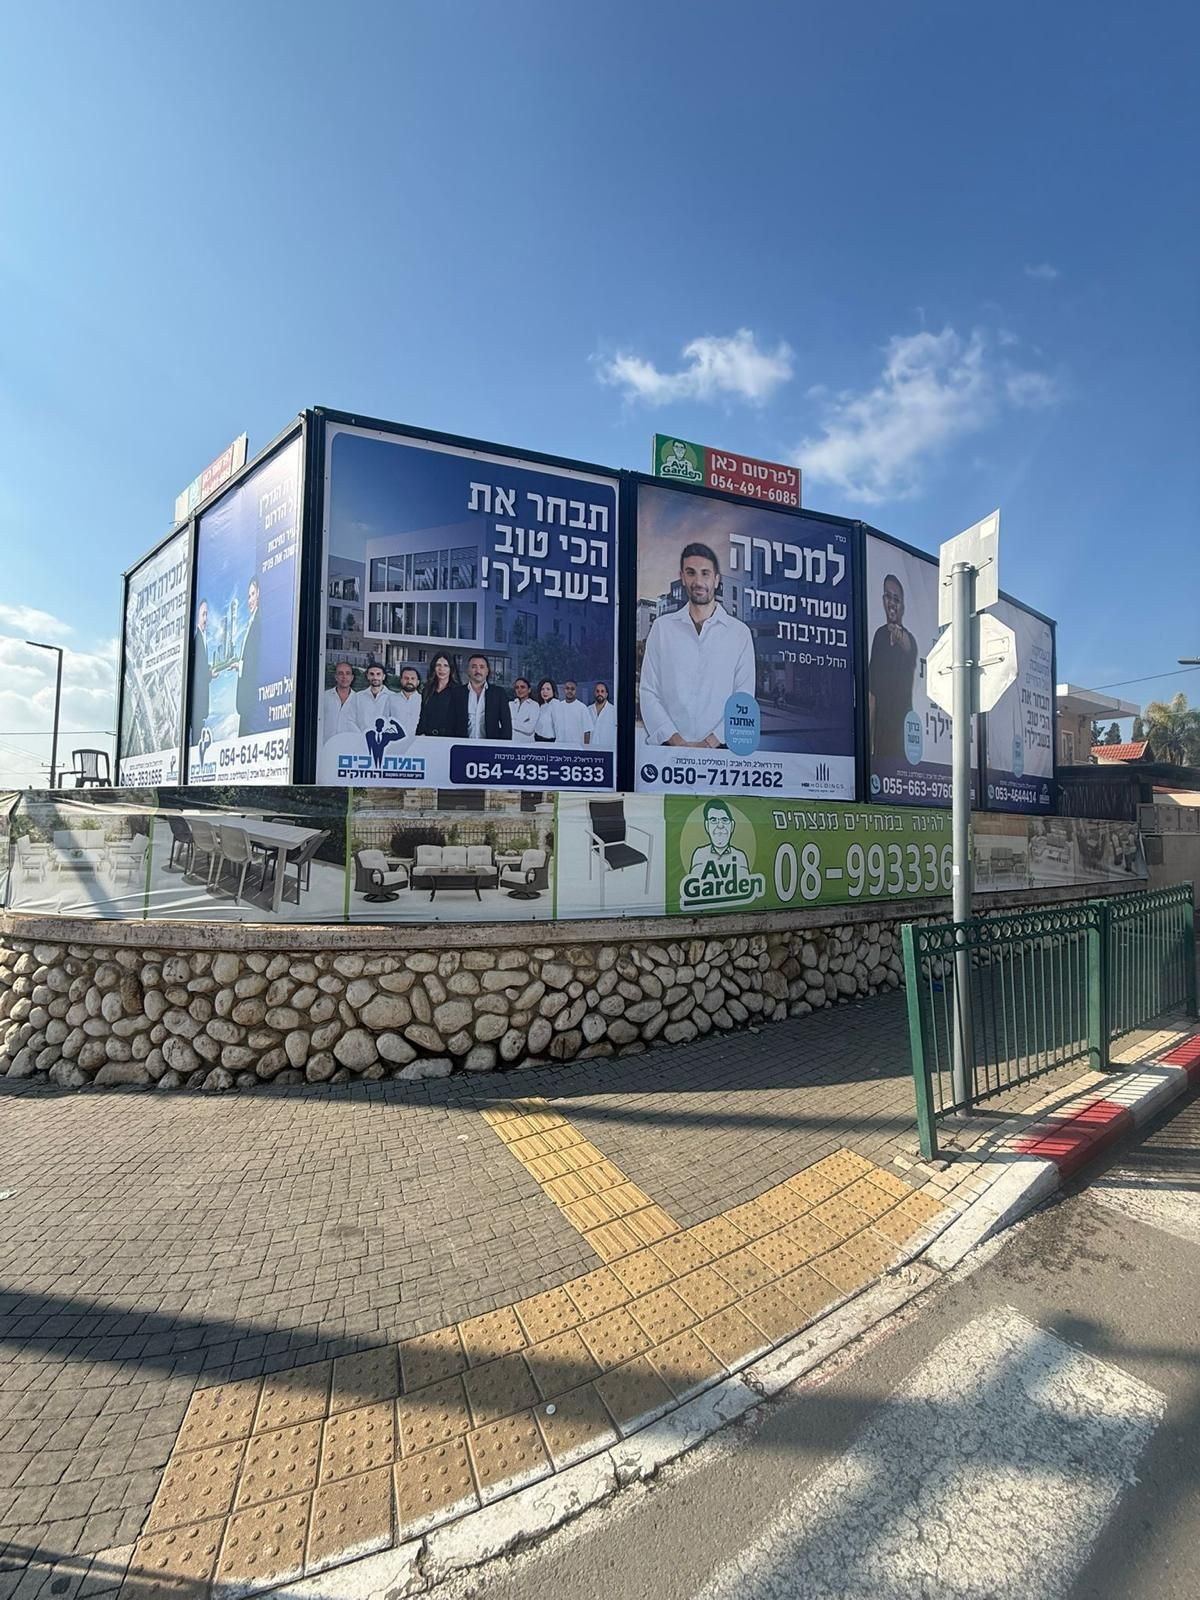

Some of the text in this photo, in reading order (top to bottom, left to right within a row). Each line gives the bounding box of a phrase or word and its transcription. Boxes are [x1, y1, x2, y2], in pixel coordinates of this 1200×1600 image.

[662, 464, 701, 481] Garden
[671, 460, 688, 469] Avi
[711, 454, 796, 486] לפרסום כאן
[711, 473, 797, 505] 054-491-6085
[468, 481, 609, 533] תבחר את
[495, 524, 608, 568] הכי טוב
[729, 533, 845, 586] למכירה
[481, 556, 609, 604] בשבילך!
[744, 587, 847, 621] שטחי מסחר
[777, 621, 848, 647] בנתיבות
[826, 654, 847, 669] החל
[1022, 688, 1032, 704] את
[736, 703, 748, 714] טל
[729, 717, 755, 727] אוחנה
[1027, 710, 1050, 730] הכי טוב
[338, 769, 382, 779] החזקים
[465, 761, 605, 783] 054-435-3633
[662, 766, 783, 788] 050-7171262
[772, 810, 945, 832] לגינה במחירים מנצחים
[701, 856, 738, 880] Avi
[684, 874, 763, 899] Garden
